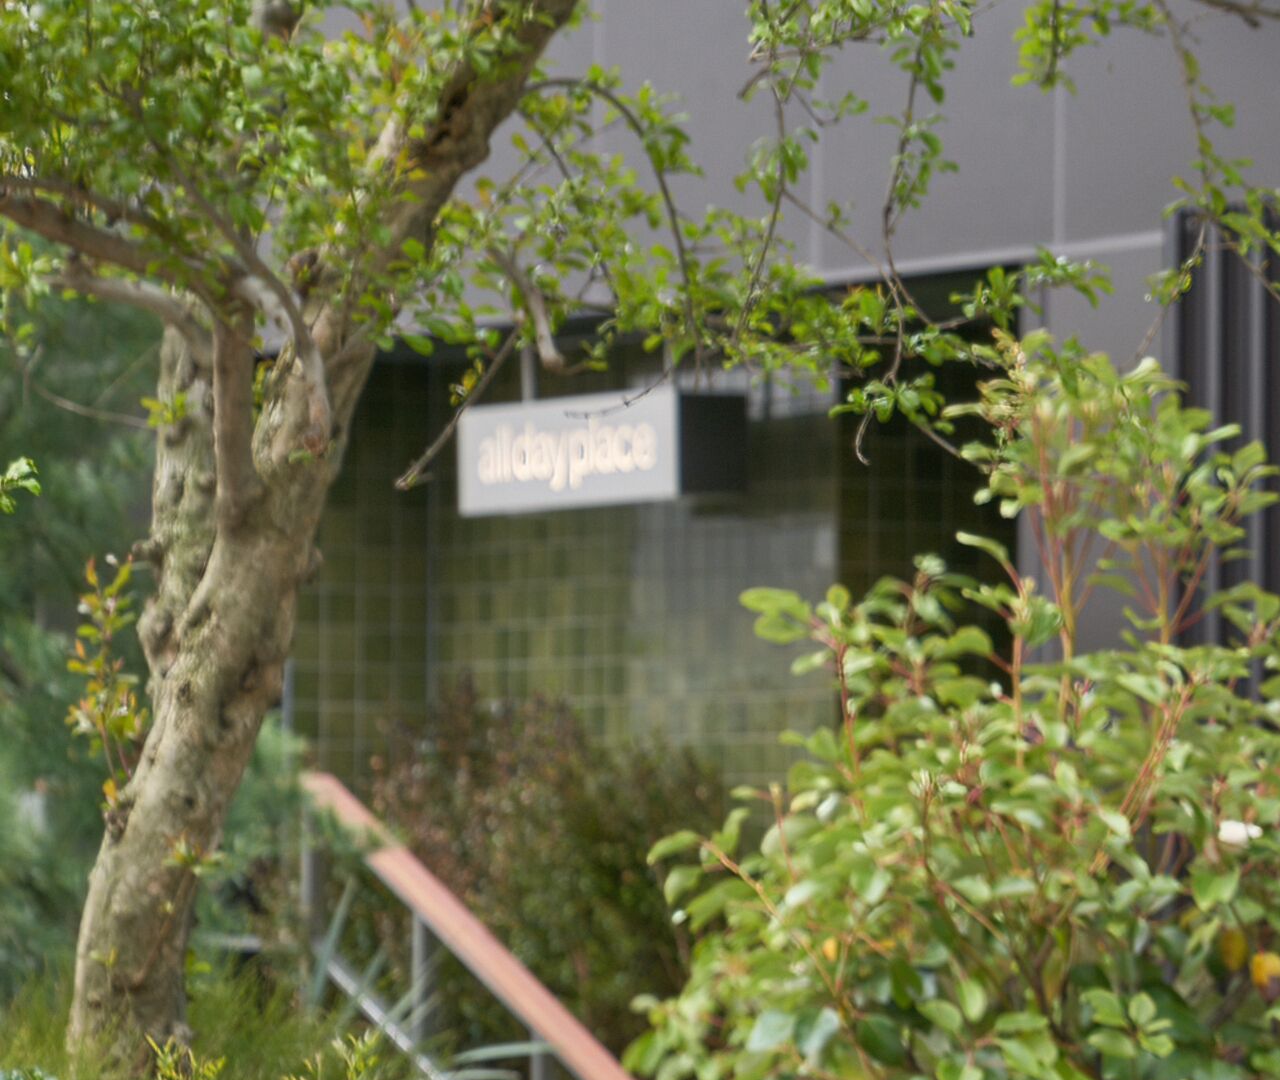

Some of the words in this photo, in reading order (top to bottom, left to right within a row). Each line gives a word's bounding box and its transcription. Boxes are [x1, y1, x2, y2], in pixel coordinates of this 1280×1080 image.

[478, 422, 512, 485] all
[512, 420, 565, 492] day
[568, 415, 658, 491] place
